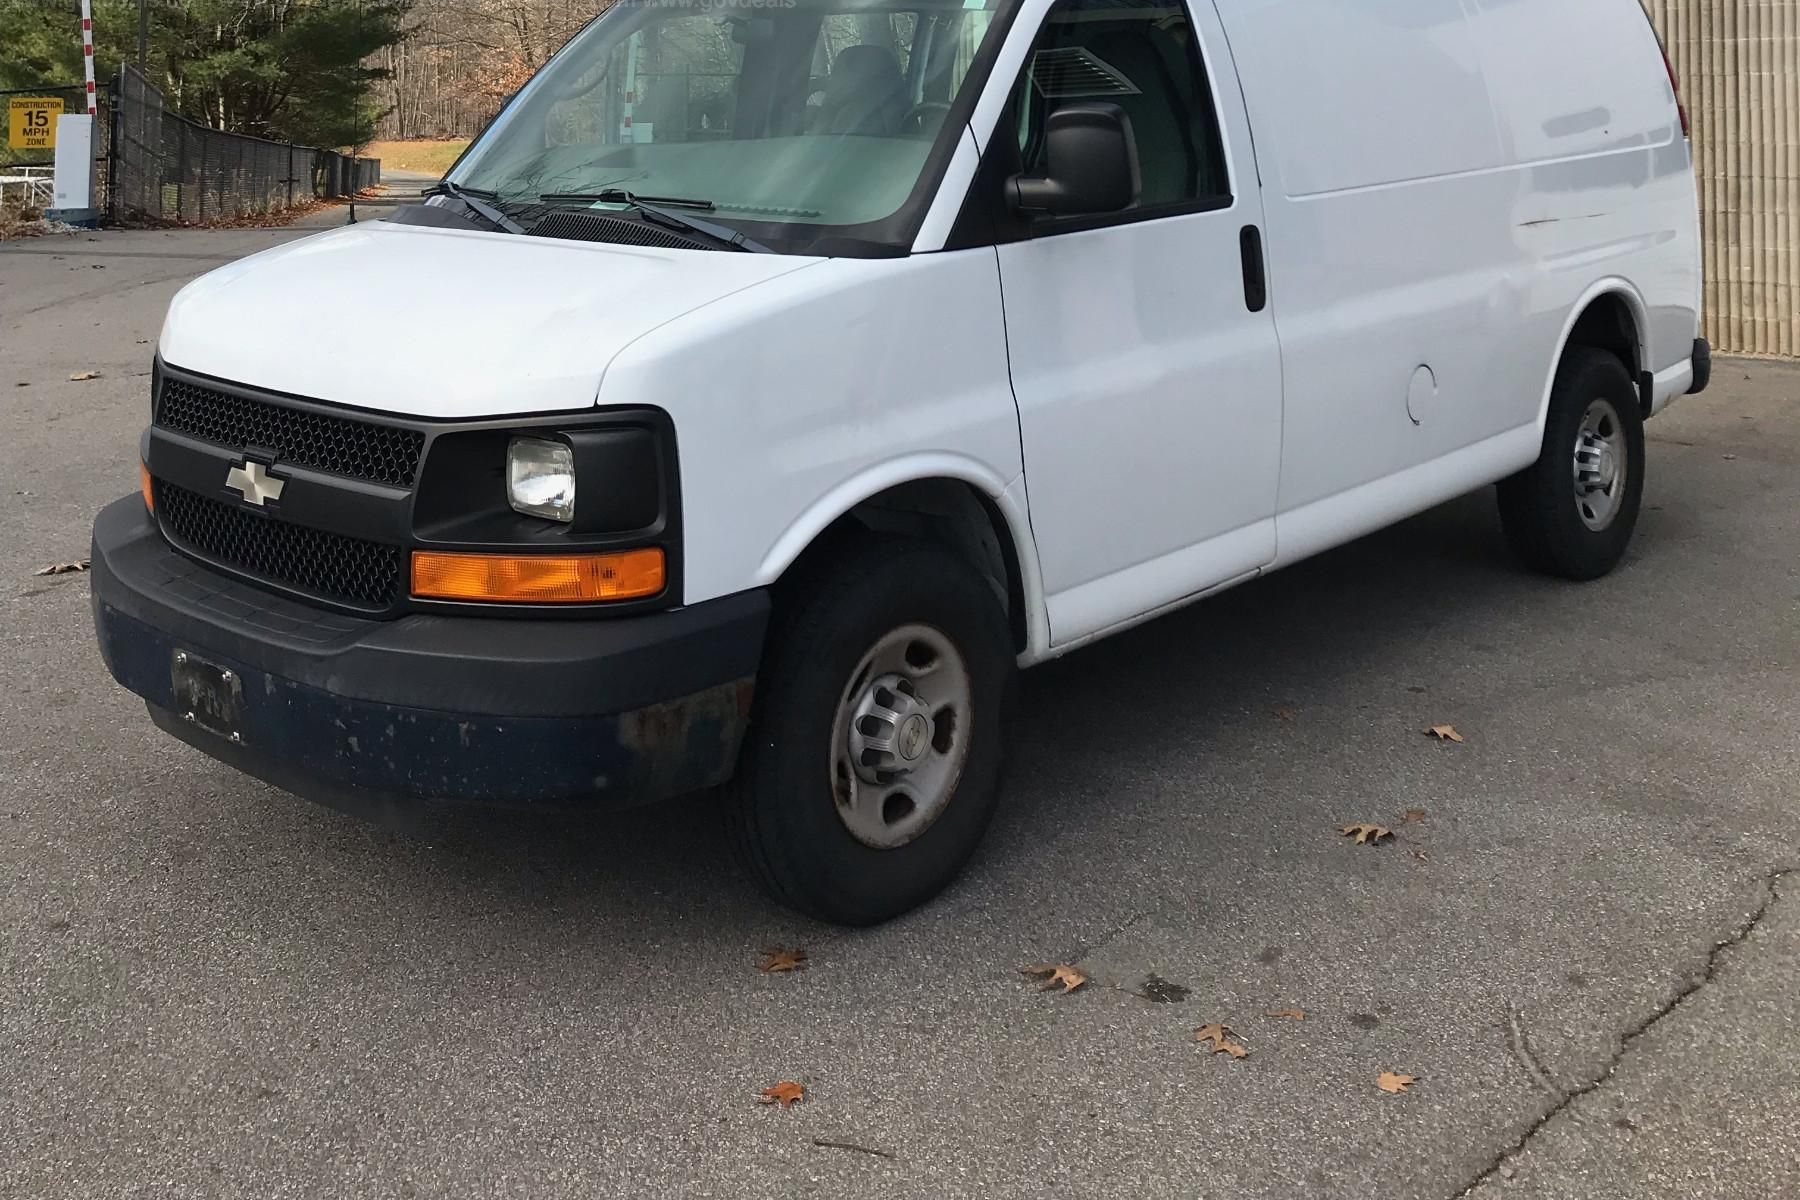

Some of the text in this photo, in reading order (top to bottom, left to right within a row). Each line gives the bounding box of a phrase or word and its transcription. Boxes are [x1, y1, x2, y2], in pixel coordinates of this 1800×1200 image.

[11, 101, 62, 109] CONSTRUCTION
[24, 110, 49, 127] 15
[22, 128, 50, 137] MPH
[26, 138, 47, 146] ZONE
